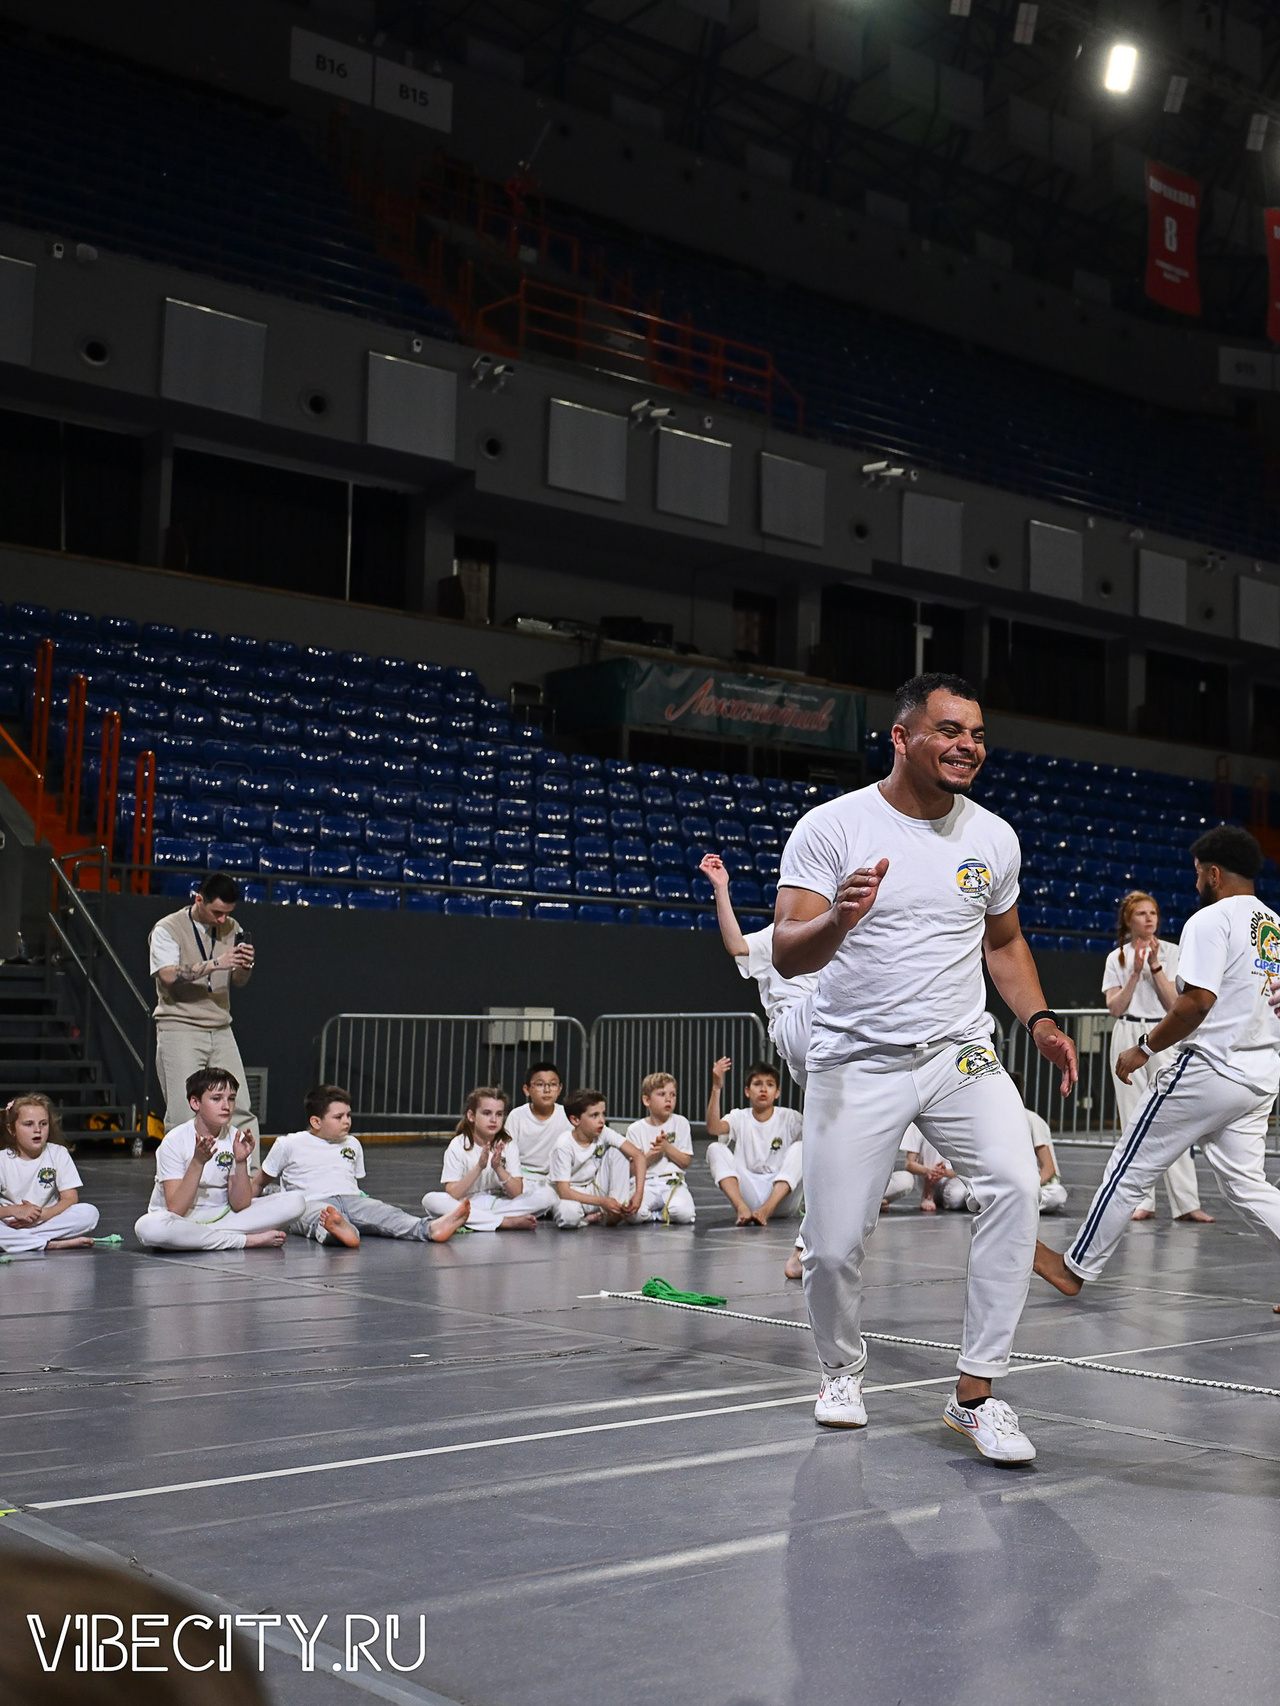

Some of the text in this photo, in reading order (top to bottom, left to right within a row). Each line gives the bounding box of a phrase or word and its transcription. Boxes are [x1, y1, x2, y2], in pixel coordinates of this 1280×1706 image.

[315, 54, 348, 79] B16
[399, 84, 429, 107] B15
[1164, 215, 1178, 252] 8
[665, 677, 835, 732] Локомотив
